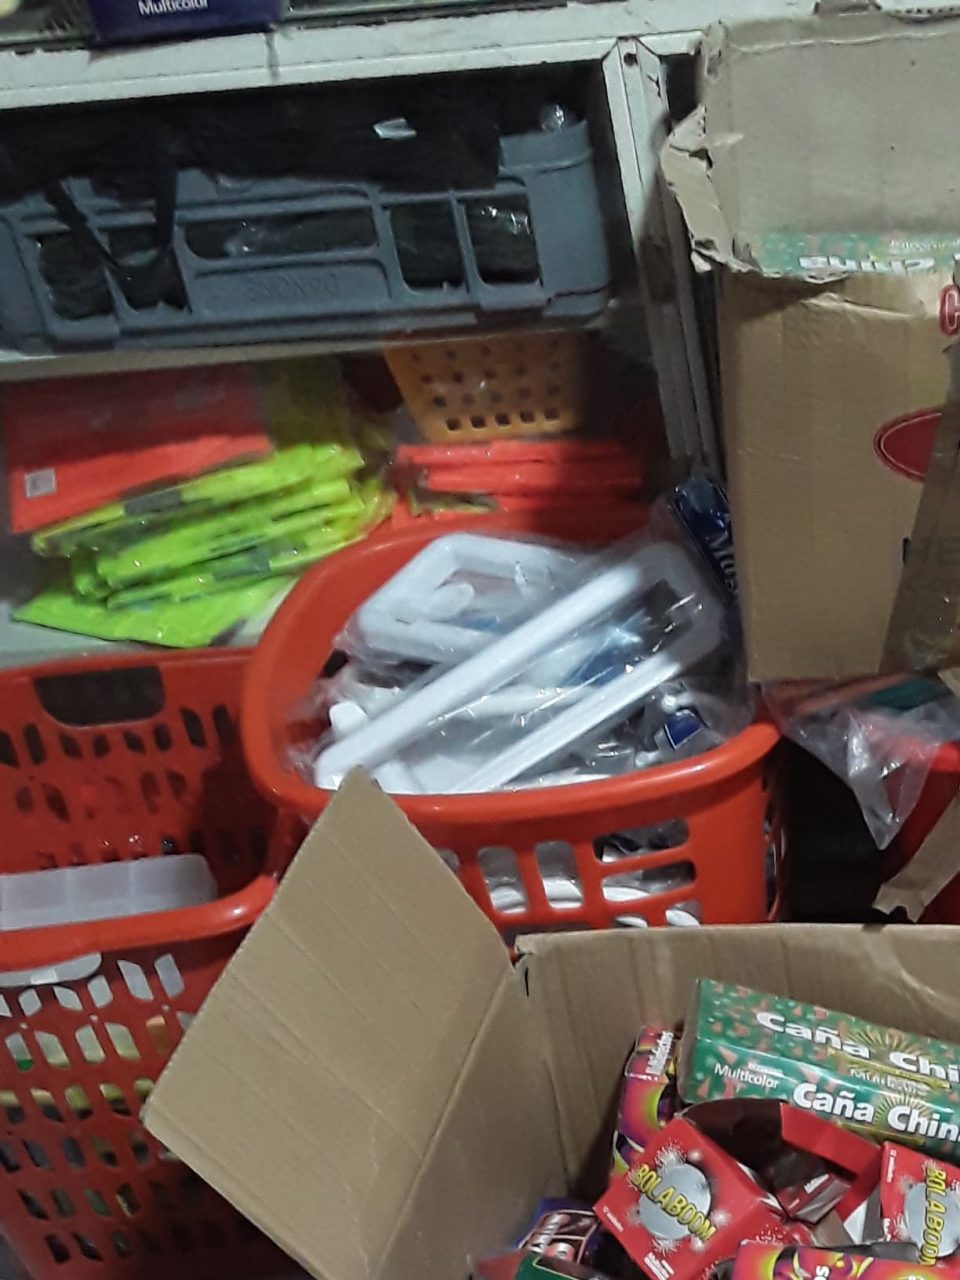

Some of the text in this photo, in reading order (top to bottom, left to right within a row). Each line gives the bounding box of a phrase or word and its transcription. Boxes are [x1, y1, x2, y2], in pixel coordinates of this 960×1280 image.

[756, 1011, 871, 1060] Caña
[714, 1063, 780, 1090] Multicolor
[793, 1083, 875, 1123] Caña
